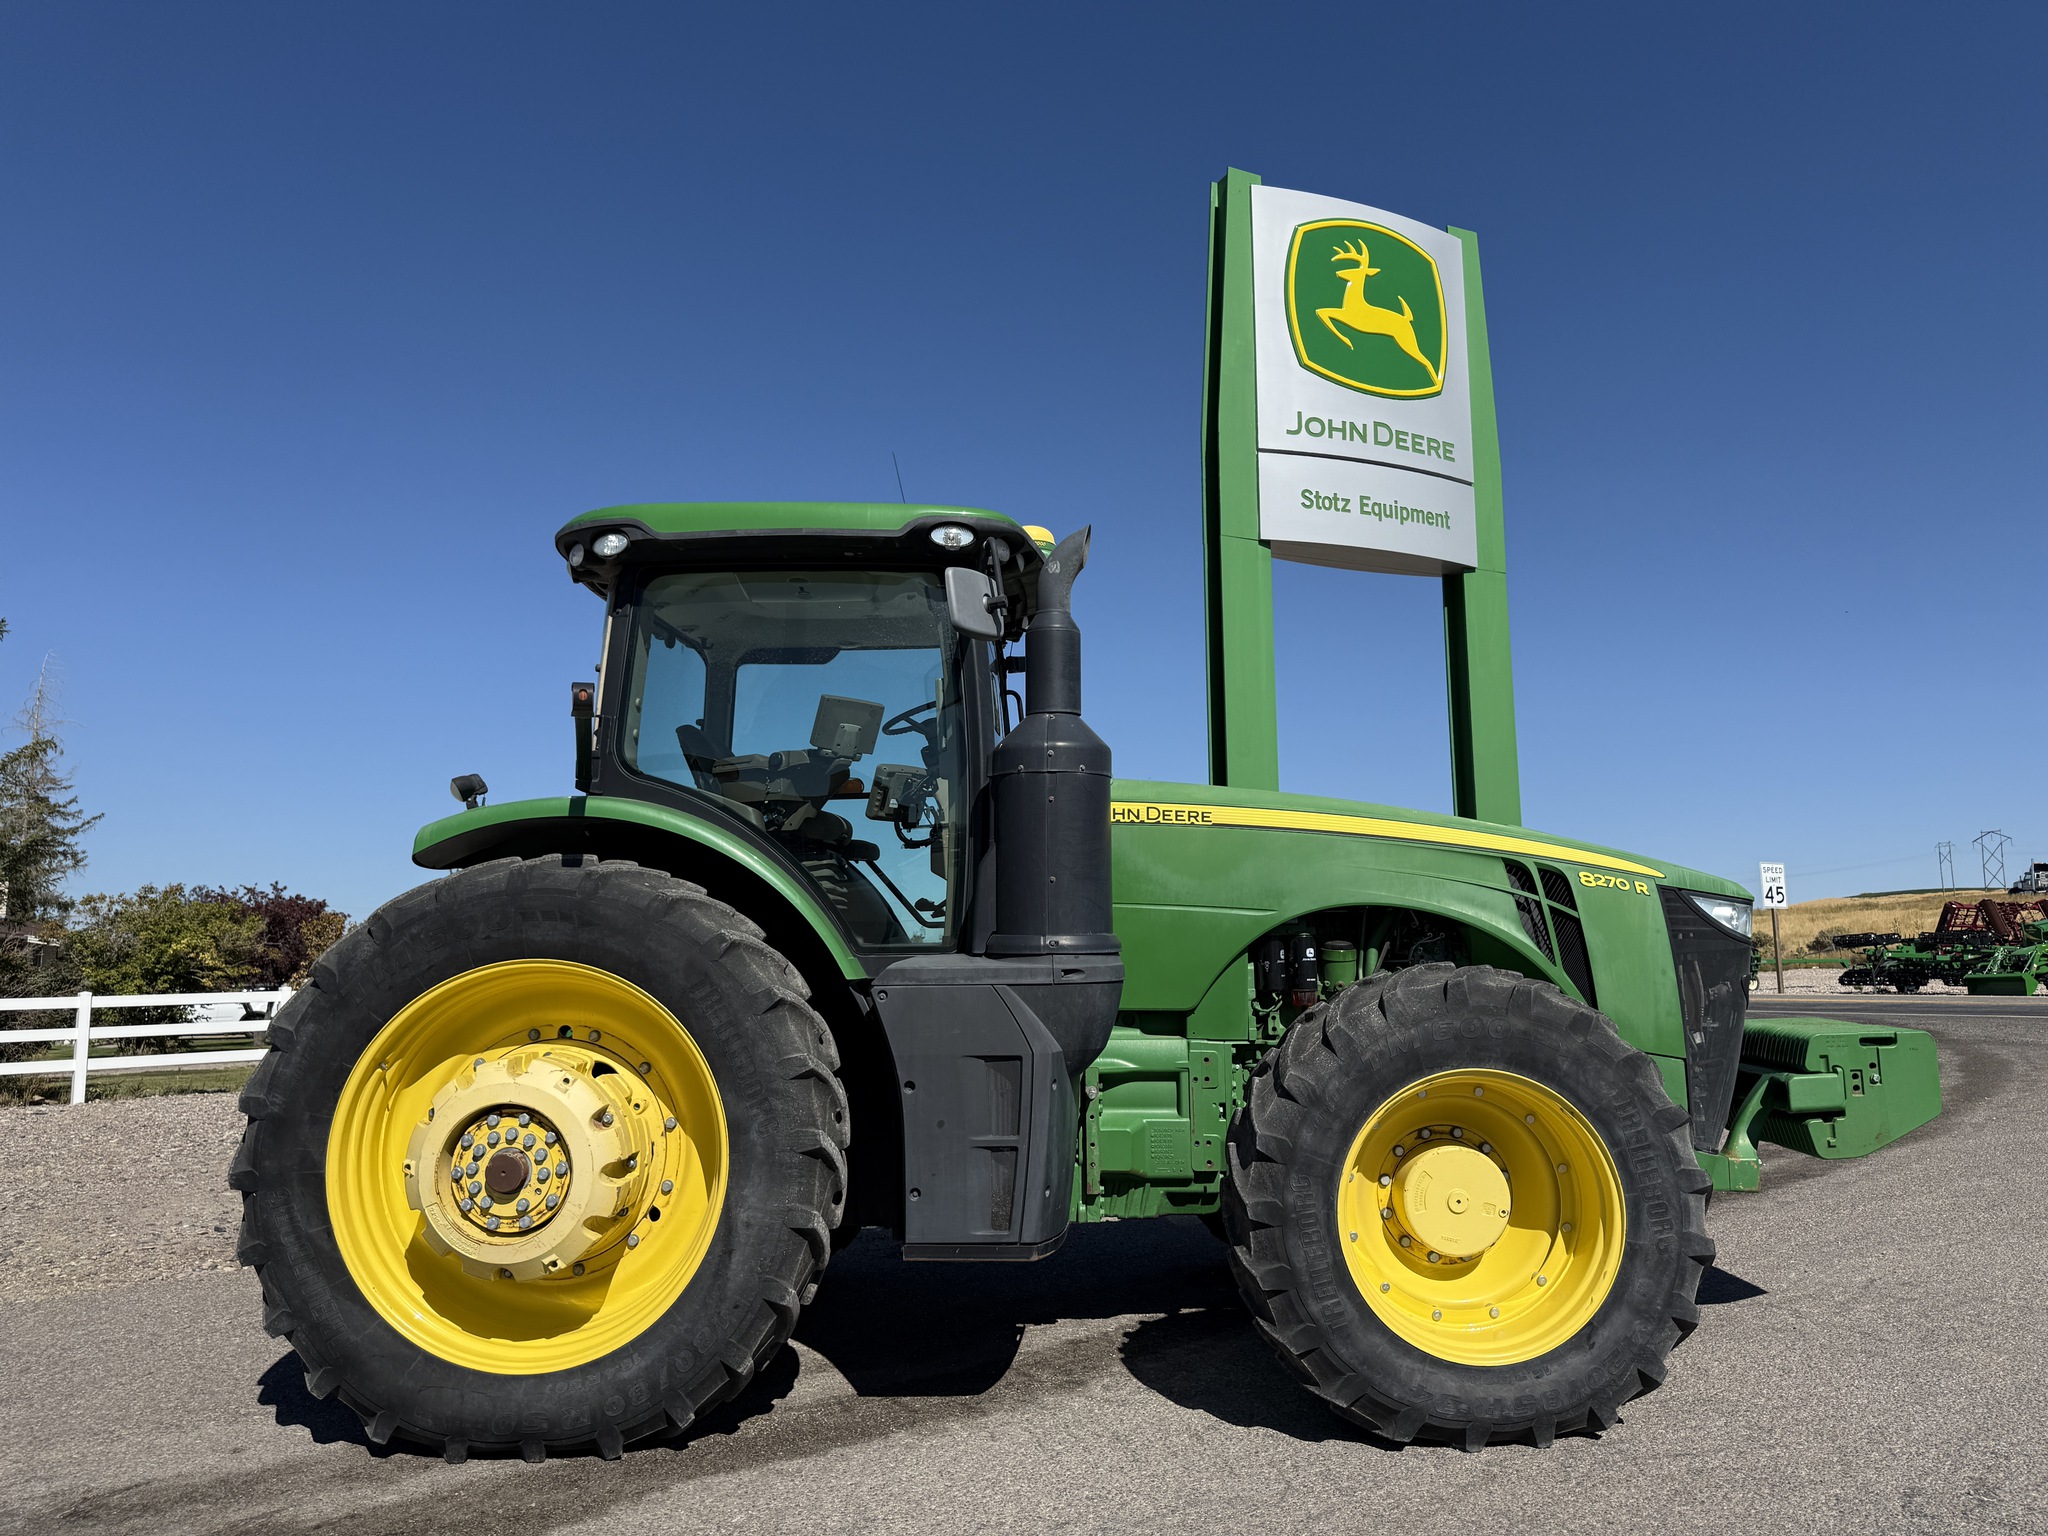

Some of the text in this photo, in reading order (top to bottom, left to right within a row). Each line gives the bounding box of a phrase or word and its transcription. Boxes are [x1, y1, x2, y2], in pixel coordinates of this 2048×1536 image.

[1286, 411, 1455, 463] JOHN DEERE
[1300, 488, 1450, 530] Stotz Equipment
[1112, 806, 1213, 823] HN DEERE
[1762, 866, 1783, 874] SPEED
[1578, 871, 1650, 896] 8270 R
[1765, 886, 1785, 904] 45
[1288, 1173, 1350, 1341] TRELLEBORG
